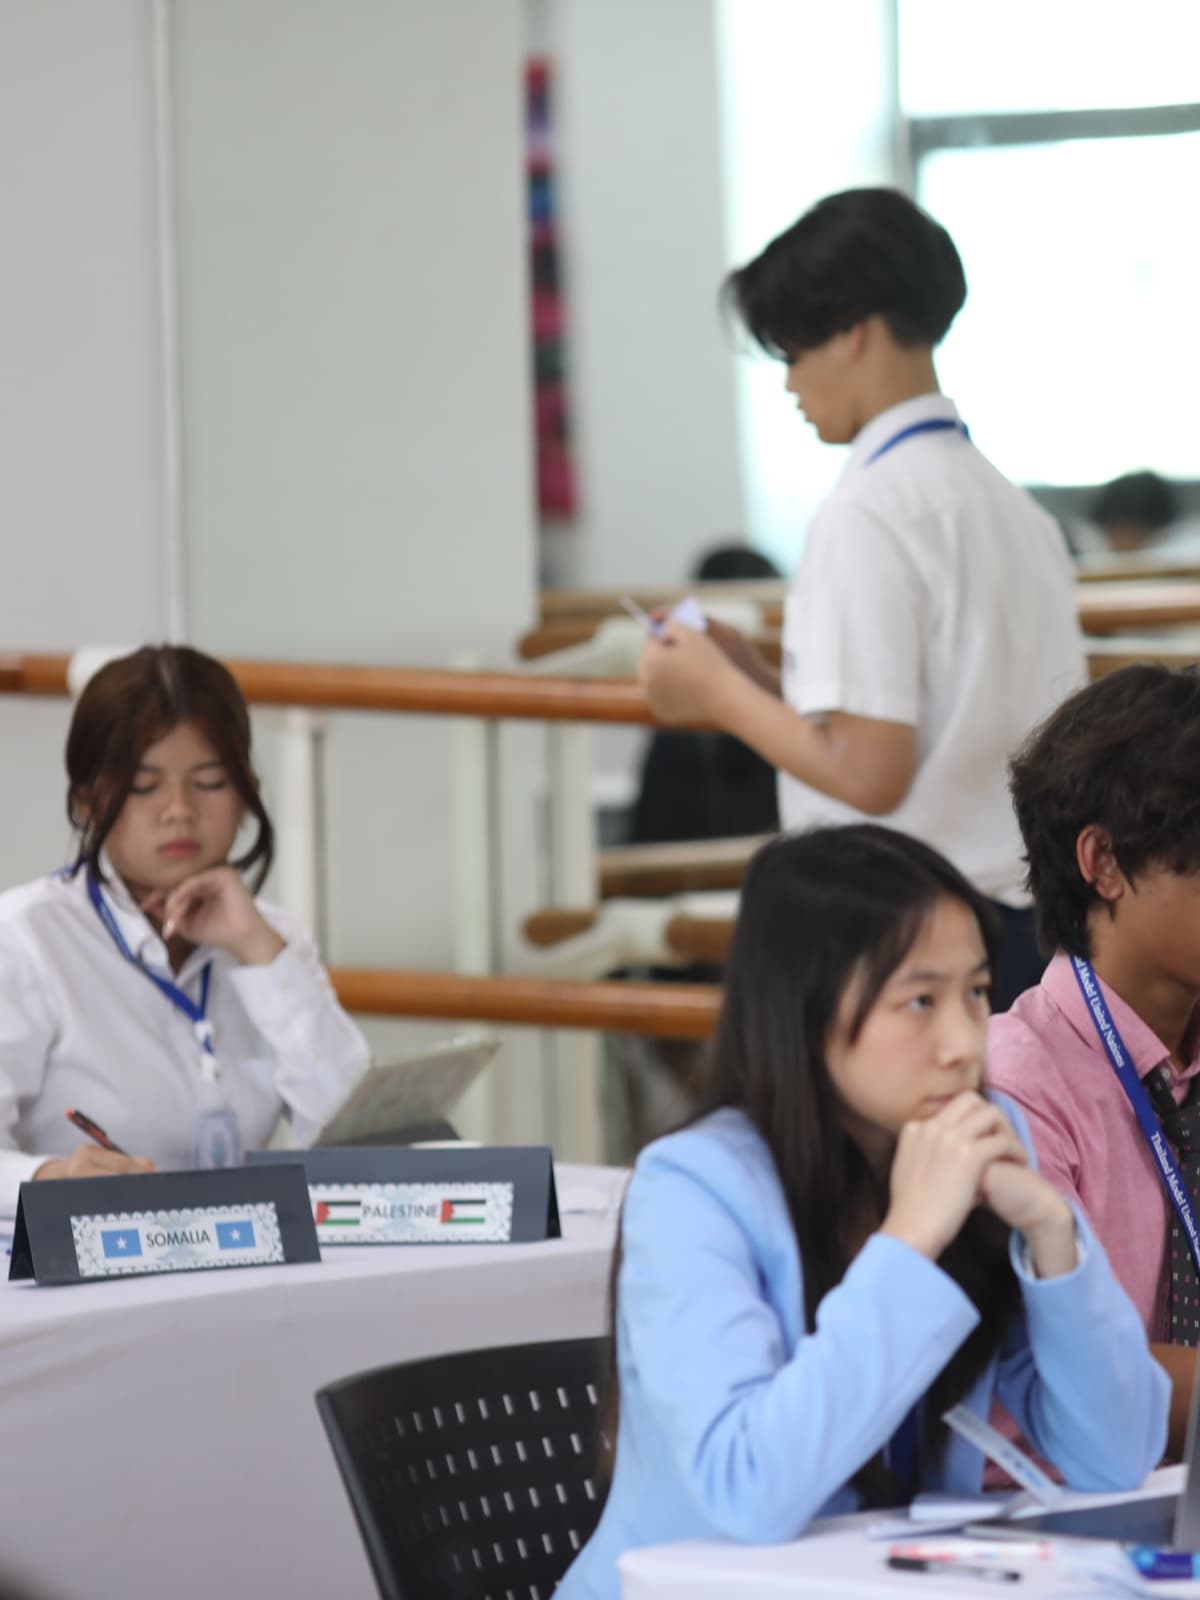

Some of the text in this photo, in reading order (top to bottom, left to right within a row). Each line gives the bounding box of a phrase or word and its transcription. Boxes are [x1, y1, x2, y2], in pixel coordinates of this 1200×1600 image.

[1079, 966, 1098, 998] Model
[1090, 997, 1111, 1031] United
[1103, 1030, 1125, 1068] Nations
[363, 1203, 437, 1219] PALESTINE
[1151, 1131, 1173, 1175] Thailand
[1167, 1172, 1187, 1206] Model
[1180, 1203, 1197, 1239] United
[147, 1230, 210, 1248] SOMALIA
